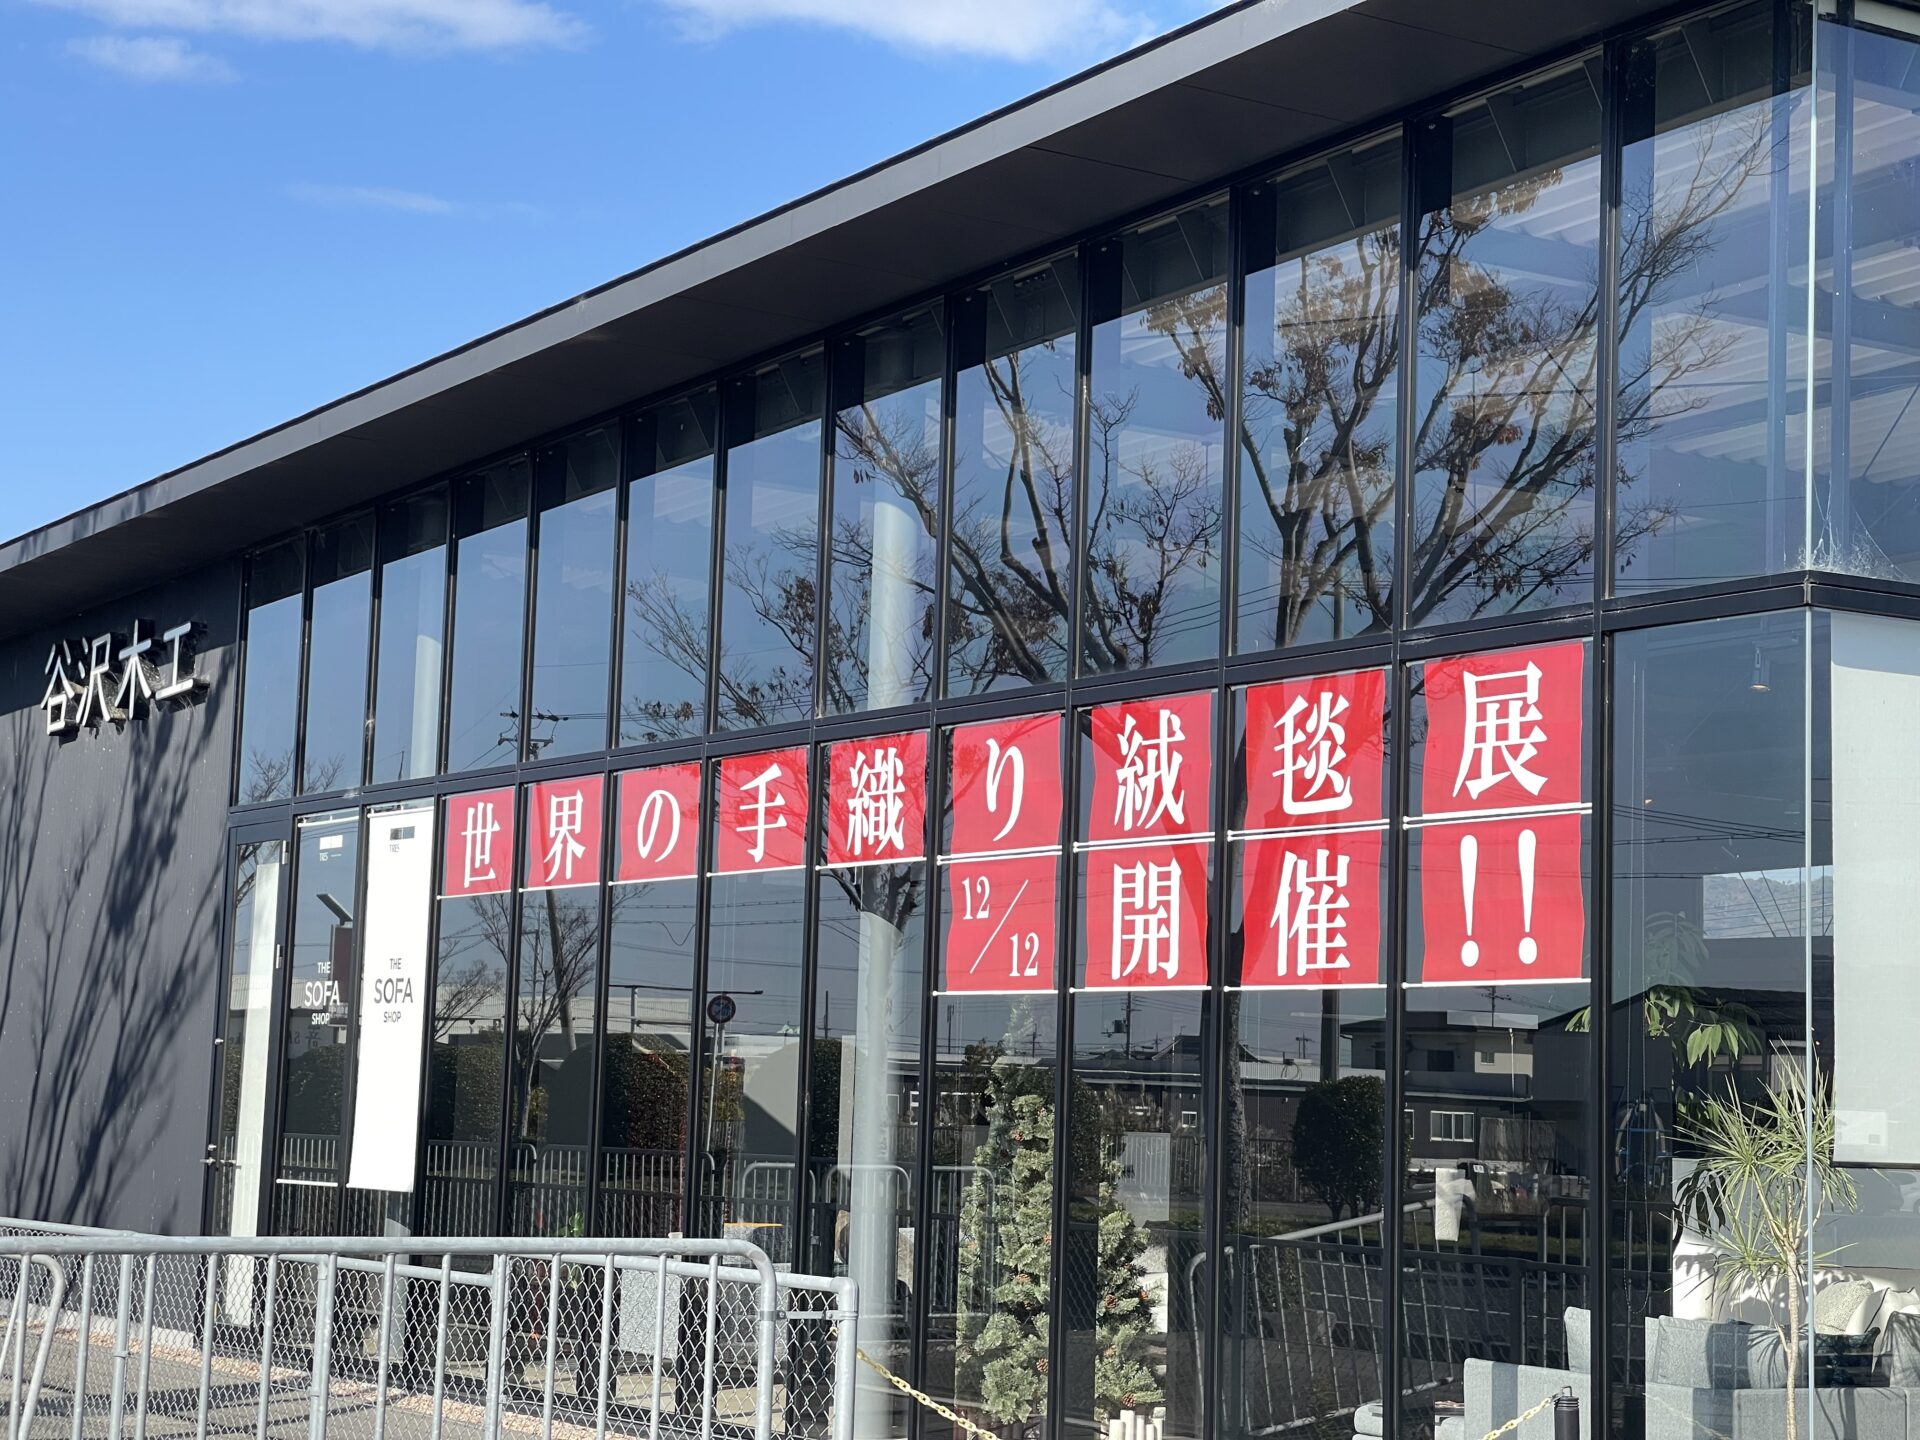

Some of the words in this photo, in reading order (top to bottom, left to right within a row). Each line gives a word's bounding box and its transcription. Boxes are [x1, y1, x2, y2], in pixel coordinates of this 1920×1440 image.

[41, 619, 194, 735] 谷沢木工
[461, 661, 1548, 888] 世界の手織り絨毯展
[317, 961, 331, 974] THE
[390, 958, 402, 970] THE
[304, 980, 341, 1006] SOFA
[374, 977, 413, 1004] SOFA
[311, 1013, 330, 1025] SHOP
[383, 1011, 402, 1023] SHOP
